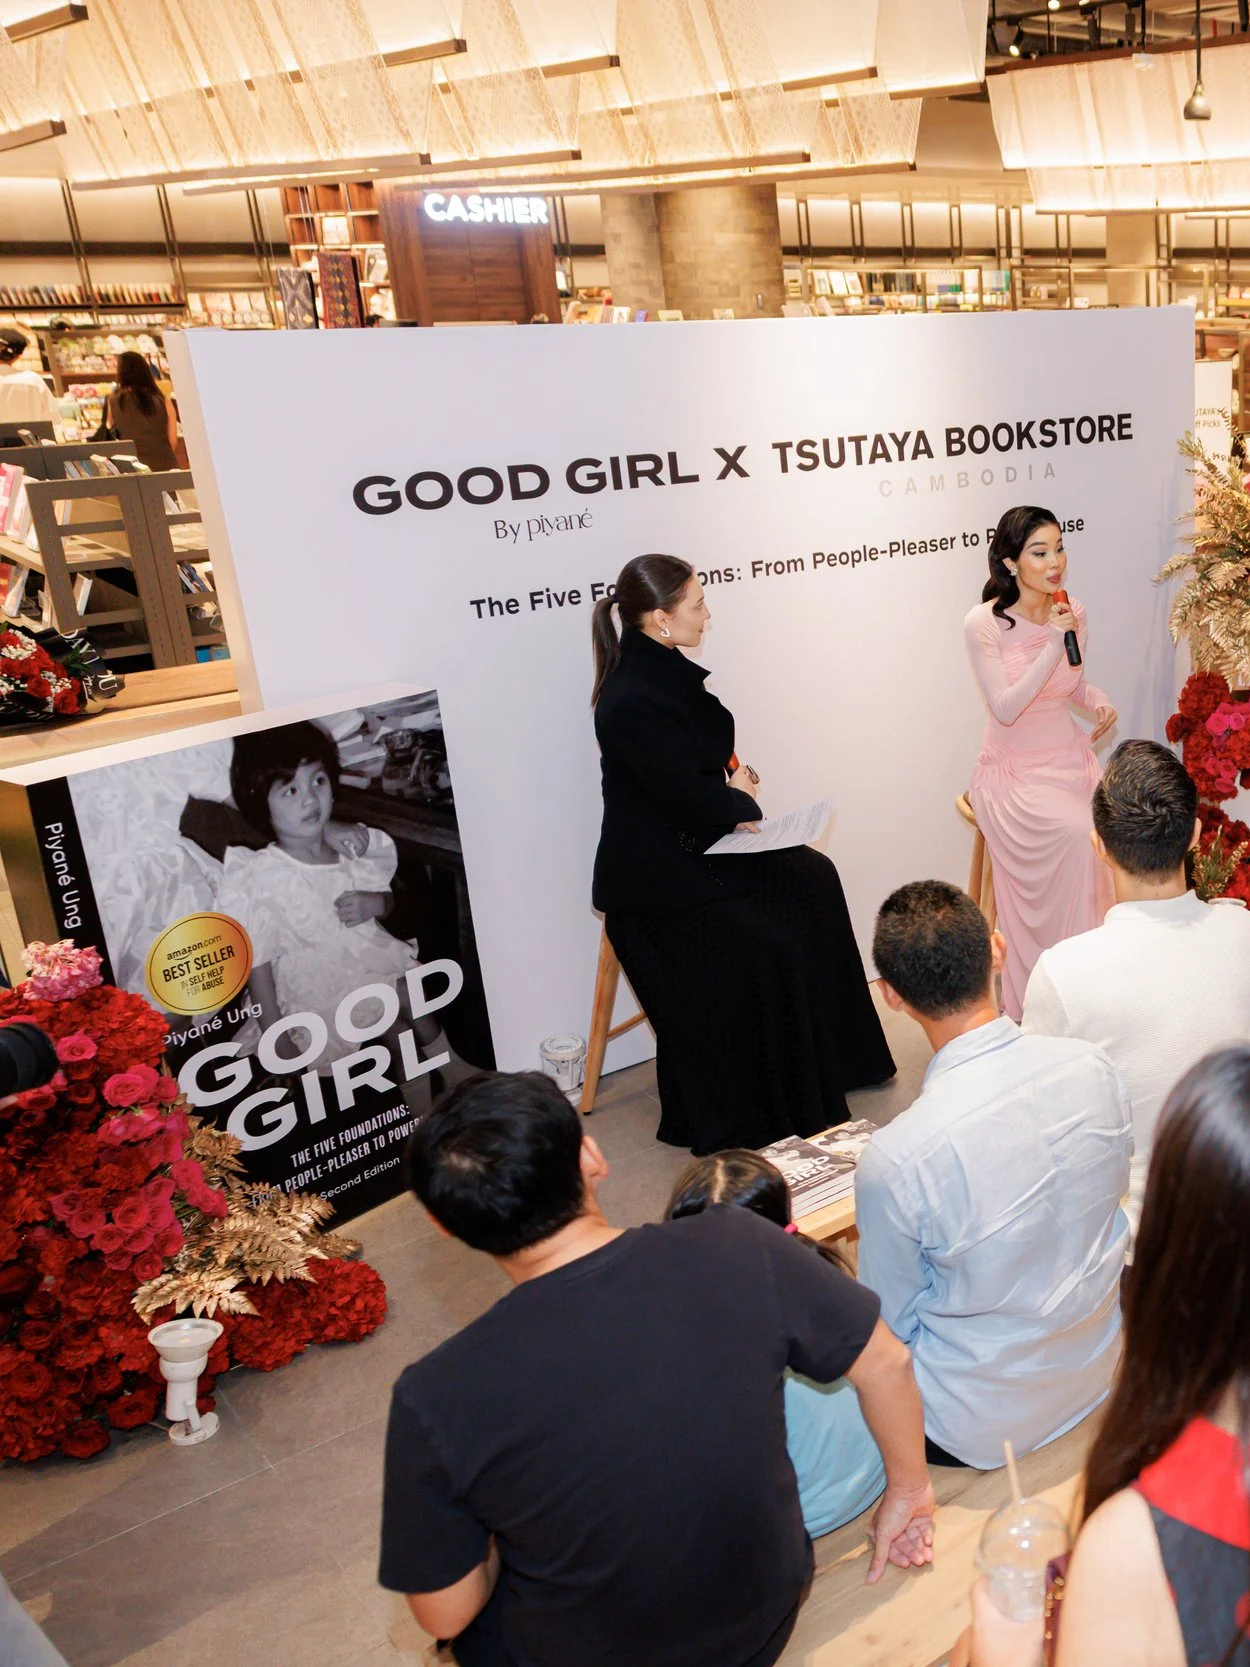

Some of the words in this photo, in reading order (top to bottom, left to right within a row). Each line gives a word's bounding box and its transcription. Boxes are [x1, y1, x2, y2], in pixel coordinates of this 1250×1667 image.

[424, 192, 549, 224] CASHIER
[352, 463, 550, 516] GOOD
[565, 451, 700, 495] GIRL
[713, 444, 751, 481] X
[772, 430, 934, 474] TSUTAYA
[945, 412, 1133, 458] BOOKSTORE
[878, 461, 1056, 498] CAMBODIA
[493, 519, 521, 544] By
[526, 507, 593, 542] piyané
[469, 596, 520, 619] The
[528, 585, 582, 612] Five
[751, 557, 805, 579] From
[812, 534, 956, 571] People-Pleaser
[961, 531, 980, 548] to
[44, 822, 76, 887] Piyané
[61, 889, 82, 930] Ung
[162, 960, 191, 983] BEST
[193, 945, 236, 971] SELLER
[166, 935, 222, 961] amazon.com
[180, 979, 189, 990] IN
[188, 972, 207, 986] SELF
[206, 965, 225, 979] HELP
[186, 985, 201, 997] FOR
[201, 975, 225, 992] ABUSE
[162, 1014, 223, 1047] Piyané
[226, 1003, 263, 1024] Ung
[177, 958, 464, 1107] GOOD
[226, 1028, 451, 1151] GIRL
[290, 1148, 312, 1168] THE
[313, 1135, 337, 1158] FIVE
[338, 1103, 410, 1146] FOUNDATIONS:
[284, 1141, 371, 1193] PEOPLE-PLEASER
[372, 1134, 386, 1151] TO
[319, 1174, 361, 1201] Second
[363, 1156, 401, 1180] Edition
[782, 1155, 830, 1178] OOD
